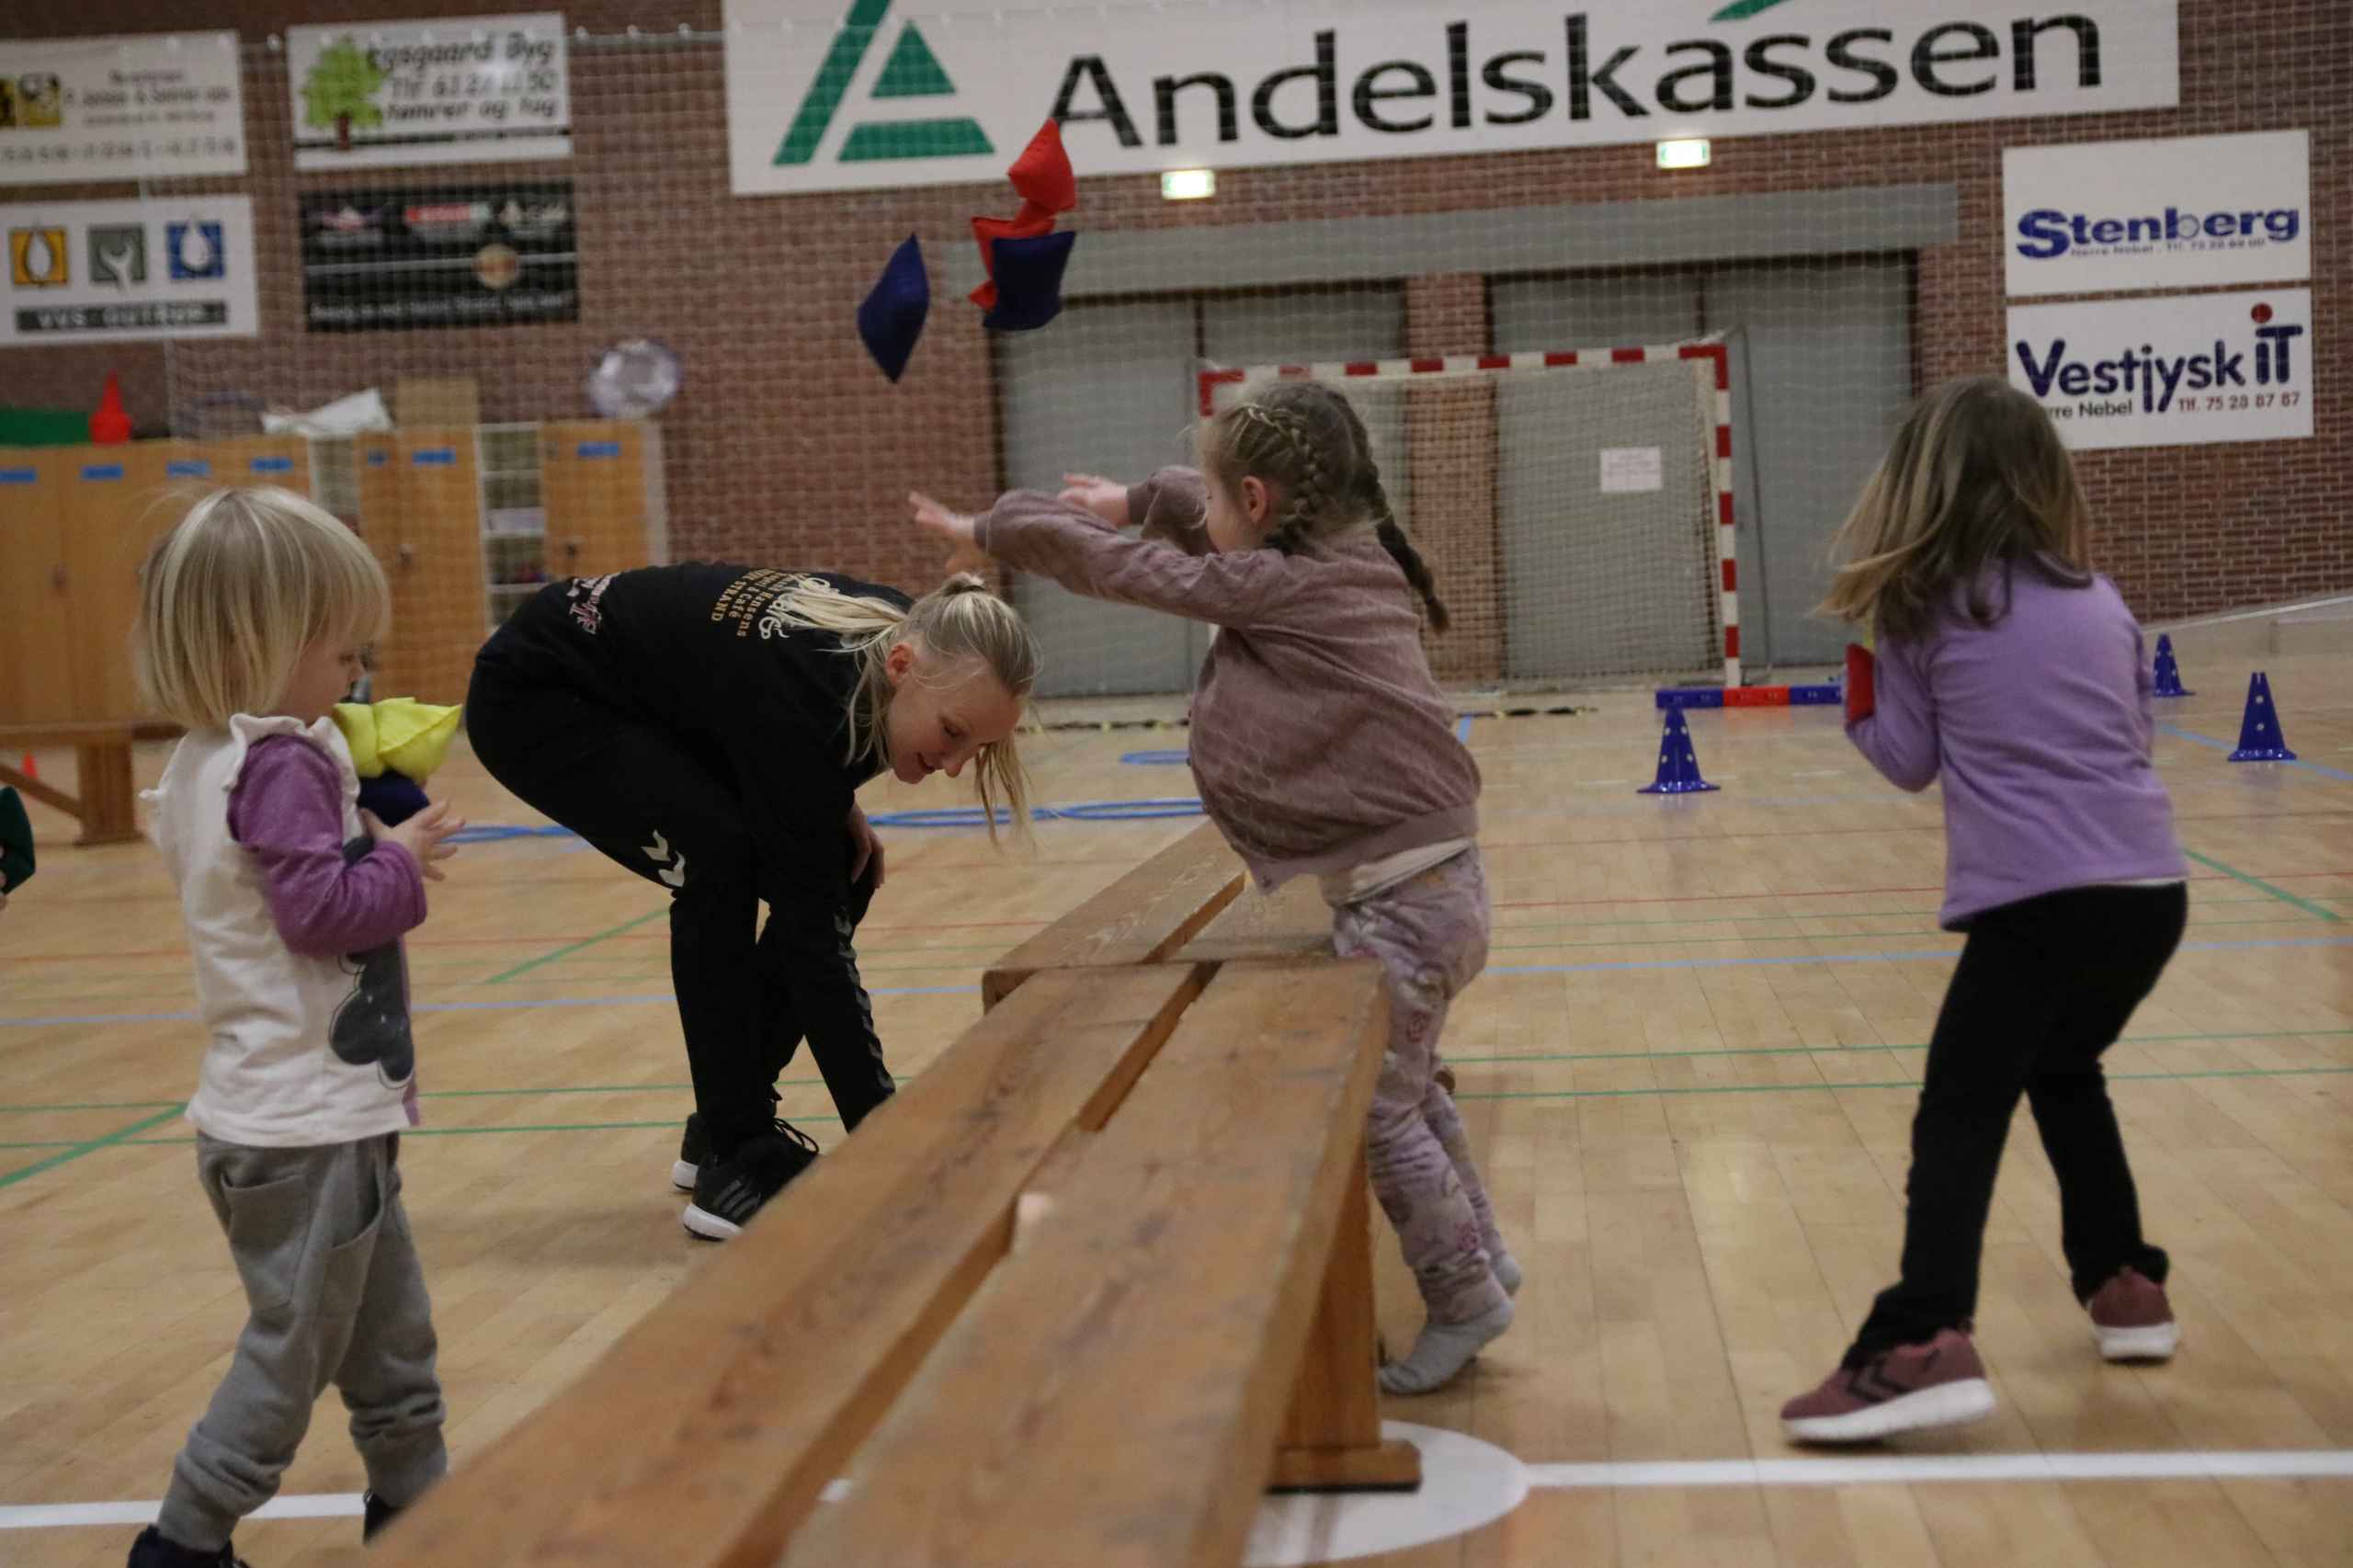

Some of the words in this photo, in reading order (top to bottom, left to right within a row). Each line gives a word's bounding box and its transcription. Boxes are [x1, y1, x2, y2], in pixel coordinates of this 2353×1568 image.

[1051, 10, 2102, 148] Andelskassen
[2016, 206, 2301, 259] Stenberg
[2016, 337, 2246, 414] Vestjysk
[2079, 399, 2133, 418] Nebel
